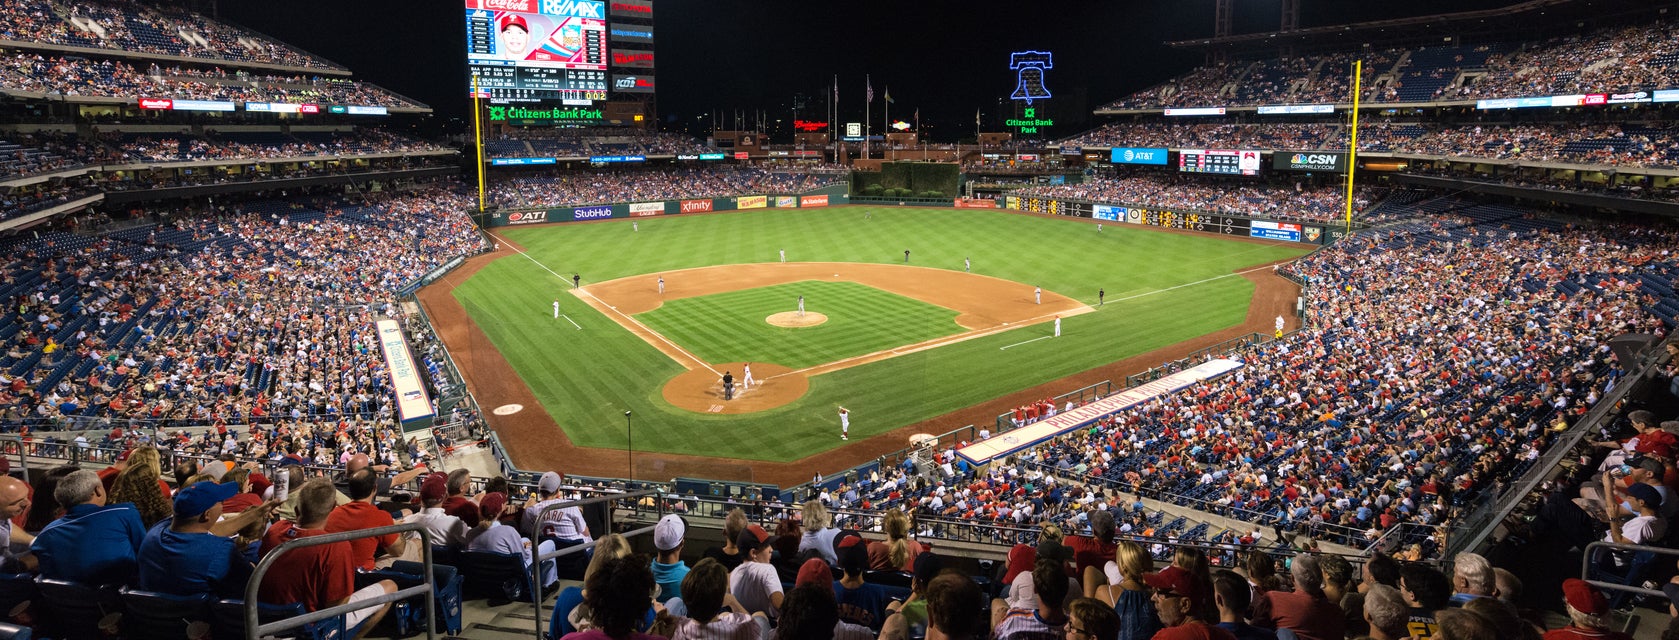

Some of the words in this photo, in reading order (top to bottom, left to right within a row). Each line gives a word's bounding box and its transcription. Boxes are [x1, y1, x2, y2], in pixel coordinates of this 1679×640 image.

[543, 0, 601, 18] RE/MAX
[508, 109, 551, 119] Citizens
[554, 110, 578, 119] Bank
[581, 110, 602, 119] Park
[1307, 155, 1337, 164] CSN
[683, 201, 710, 212] xfinity
[575, 208, 611, 218] StubHub
[1045, 394, 1138, 429] PHILADELPHIA
[1136, 376, 1187, 396] PHILLIES
[543, 511, 564, 522] ARD
